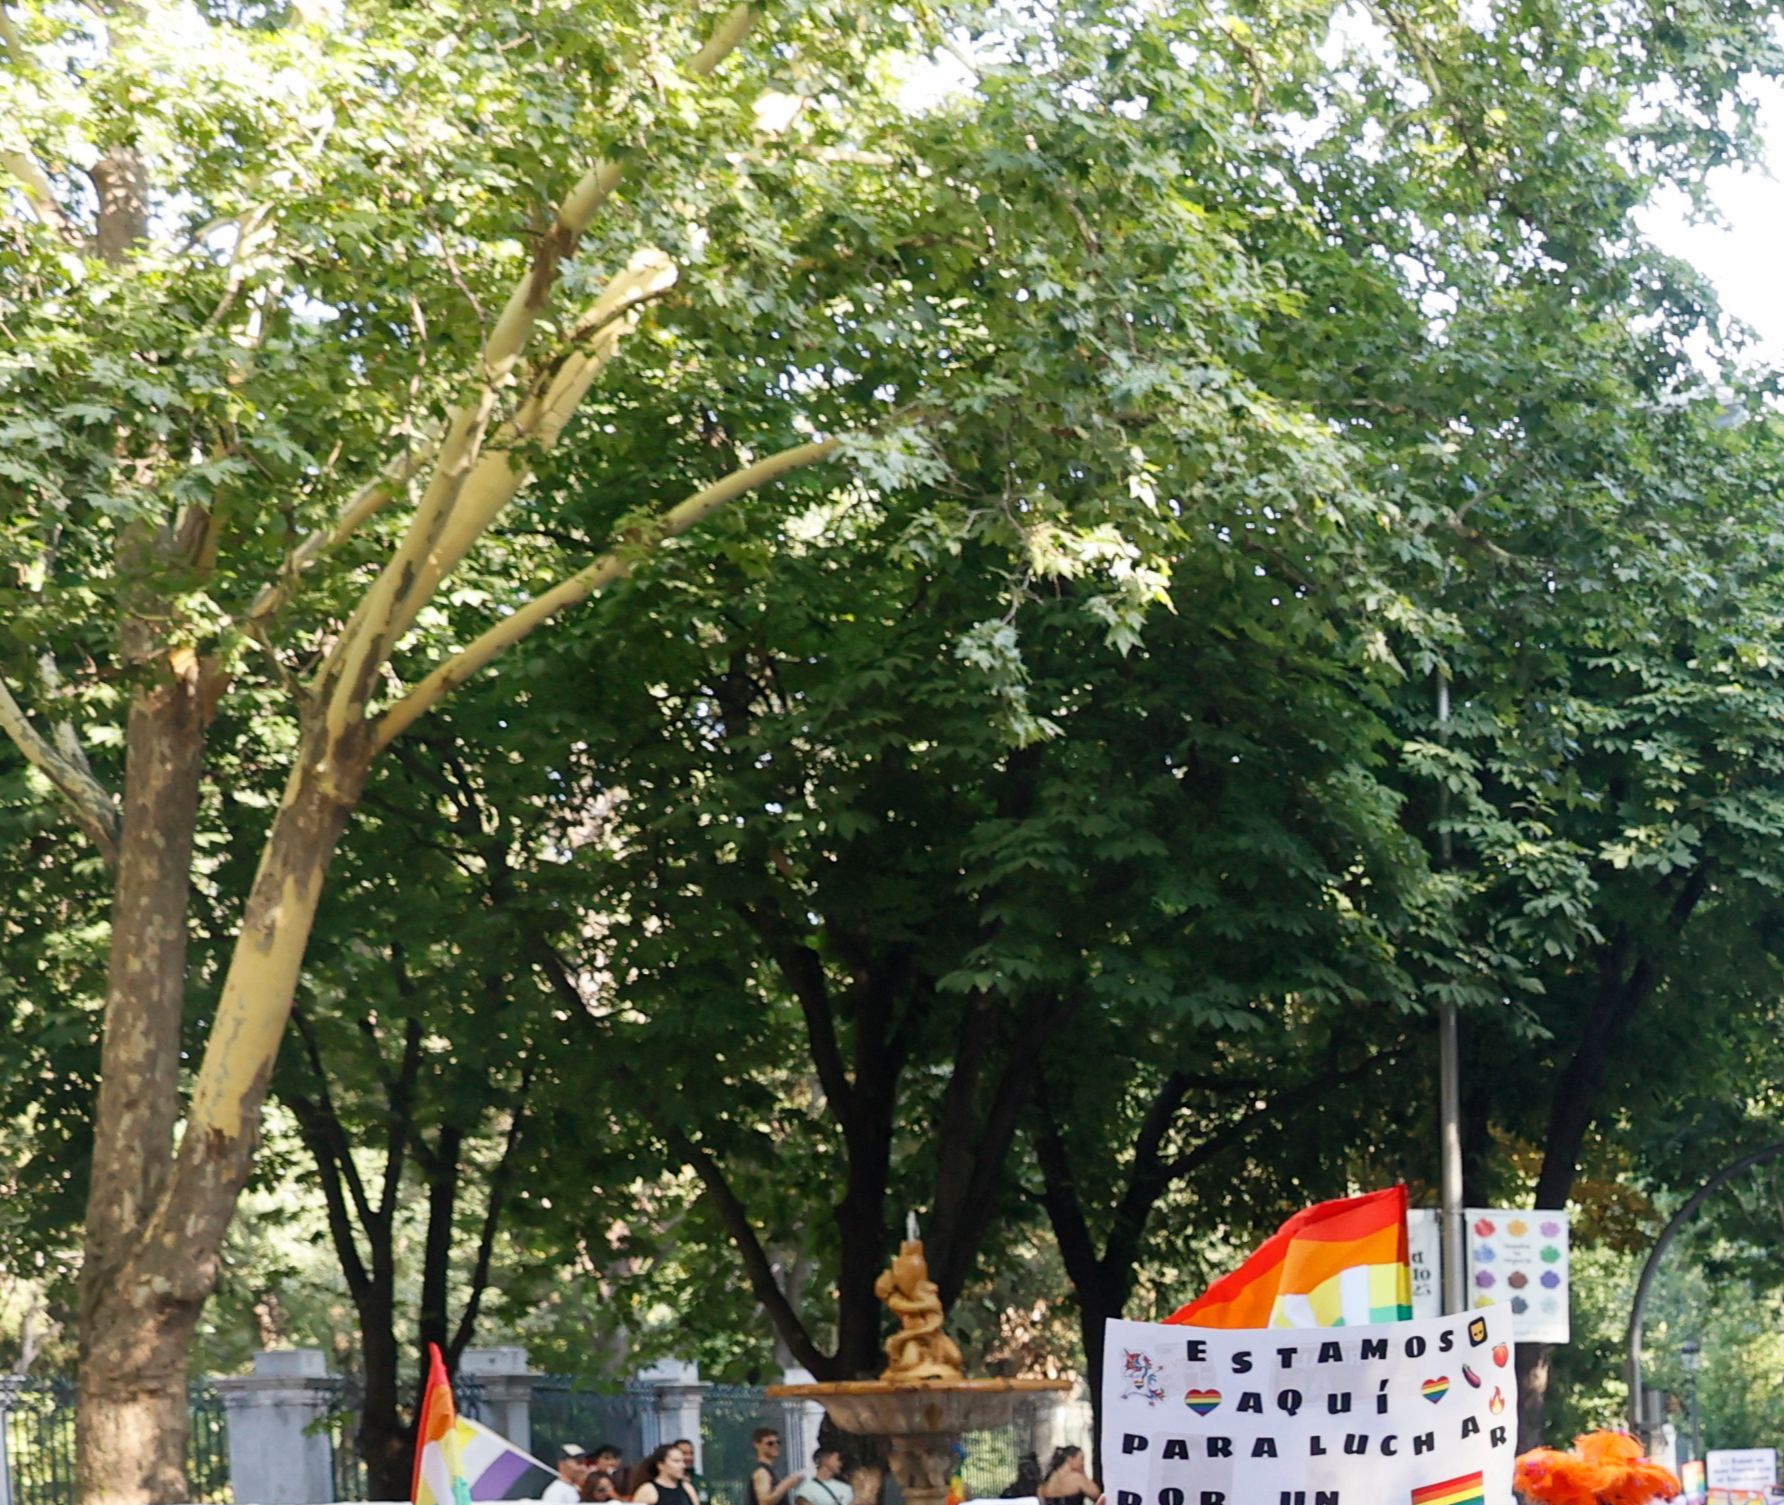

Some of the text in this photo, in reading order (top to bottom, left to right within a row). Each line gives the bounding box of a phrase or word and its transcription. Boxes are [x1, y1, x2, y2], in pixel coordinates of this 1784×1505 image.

[1186, 1328, 1455, 1375] ESTAMOS
[1235, 1378, 1391, 1417] AQUÍ
[1122, 1414, 1507, 1462] PARA LUCHAR
